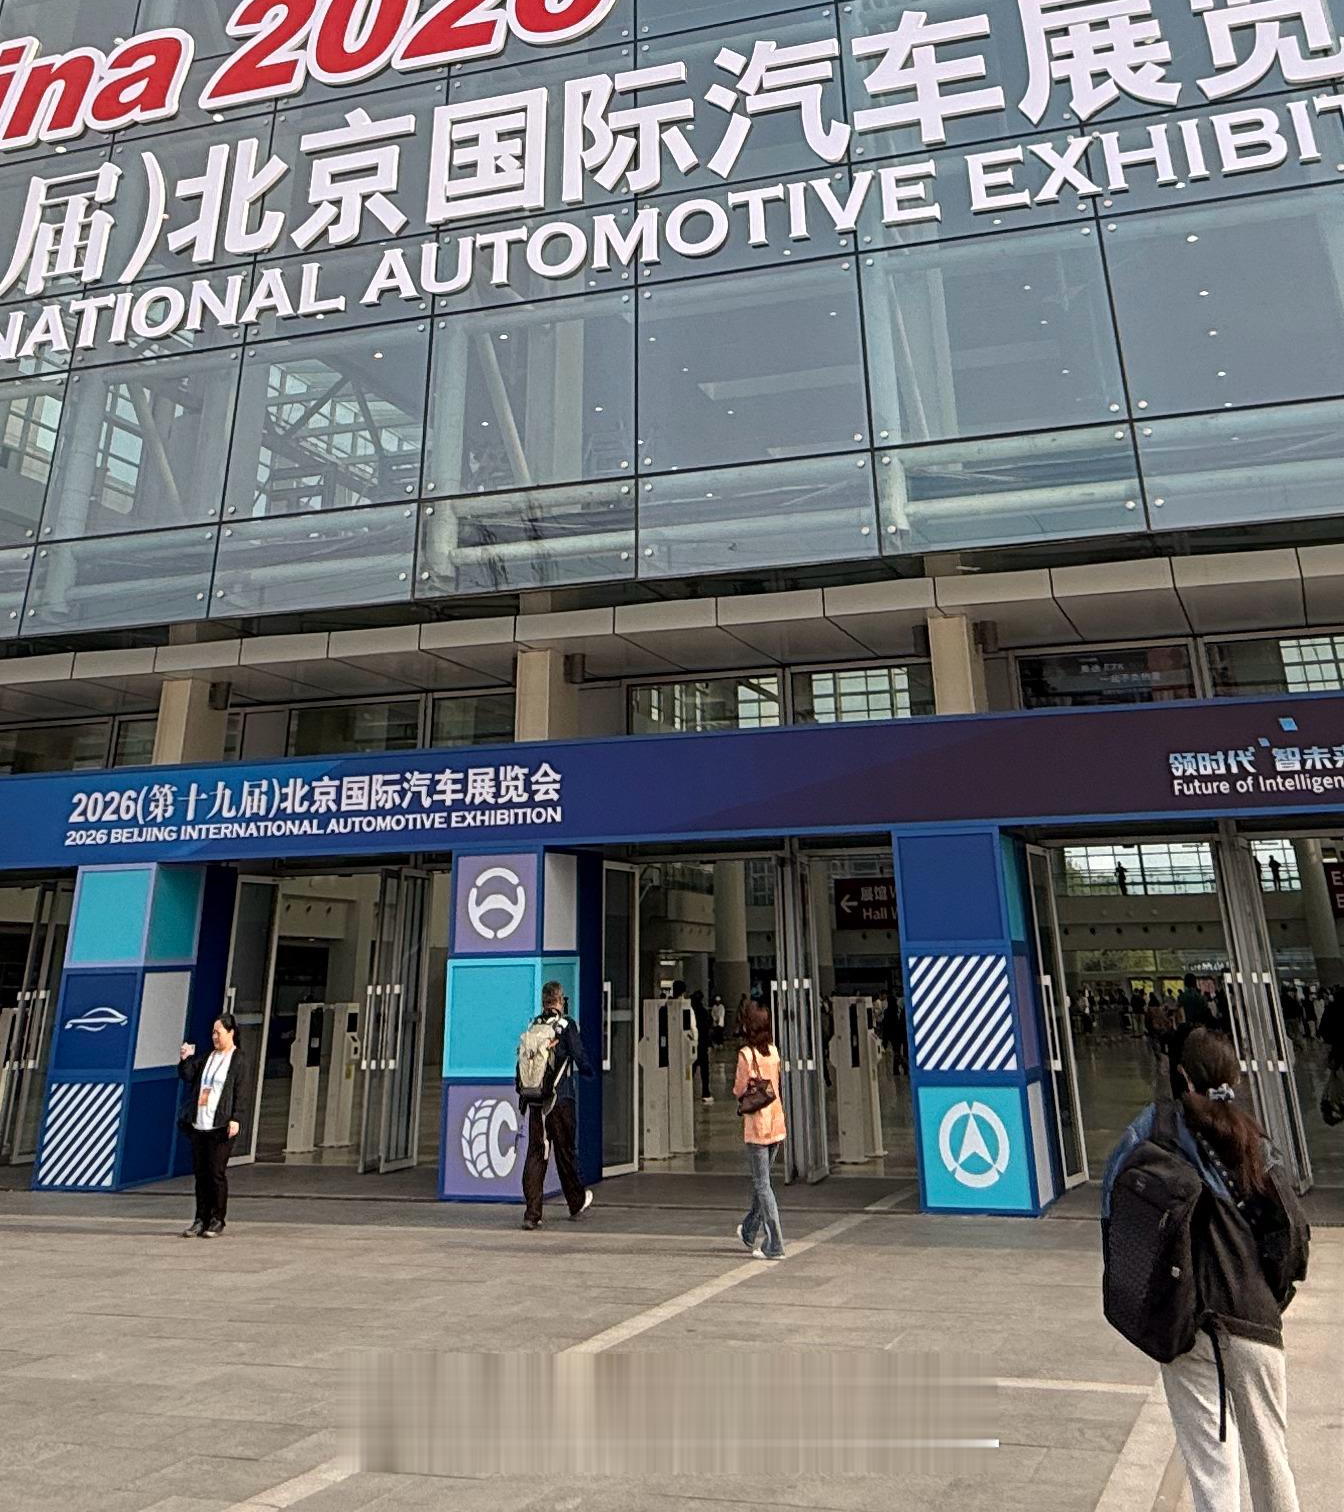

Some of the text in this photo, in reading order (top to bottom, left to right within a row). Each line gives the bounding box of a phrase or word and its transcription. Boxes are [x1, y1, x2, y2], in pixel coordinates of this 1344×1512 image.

[360, 160, 942, 307] AUTOMOTIVE
[1169, 746, 1257, 776] 领时代
[68, 762, 562, 825] 2026(第十九届)北京国际汽车展览会
[1173, 779, 1230, 796] Future
[1236, 776, 1254, 793] of
[64, 806, 562, 846] 2026 BEIJING INTERNATIONAL AUTOMOTIVE EXHIBITION
[863, 907, 888, 920] Hall
